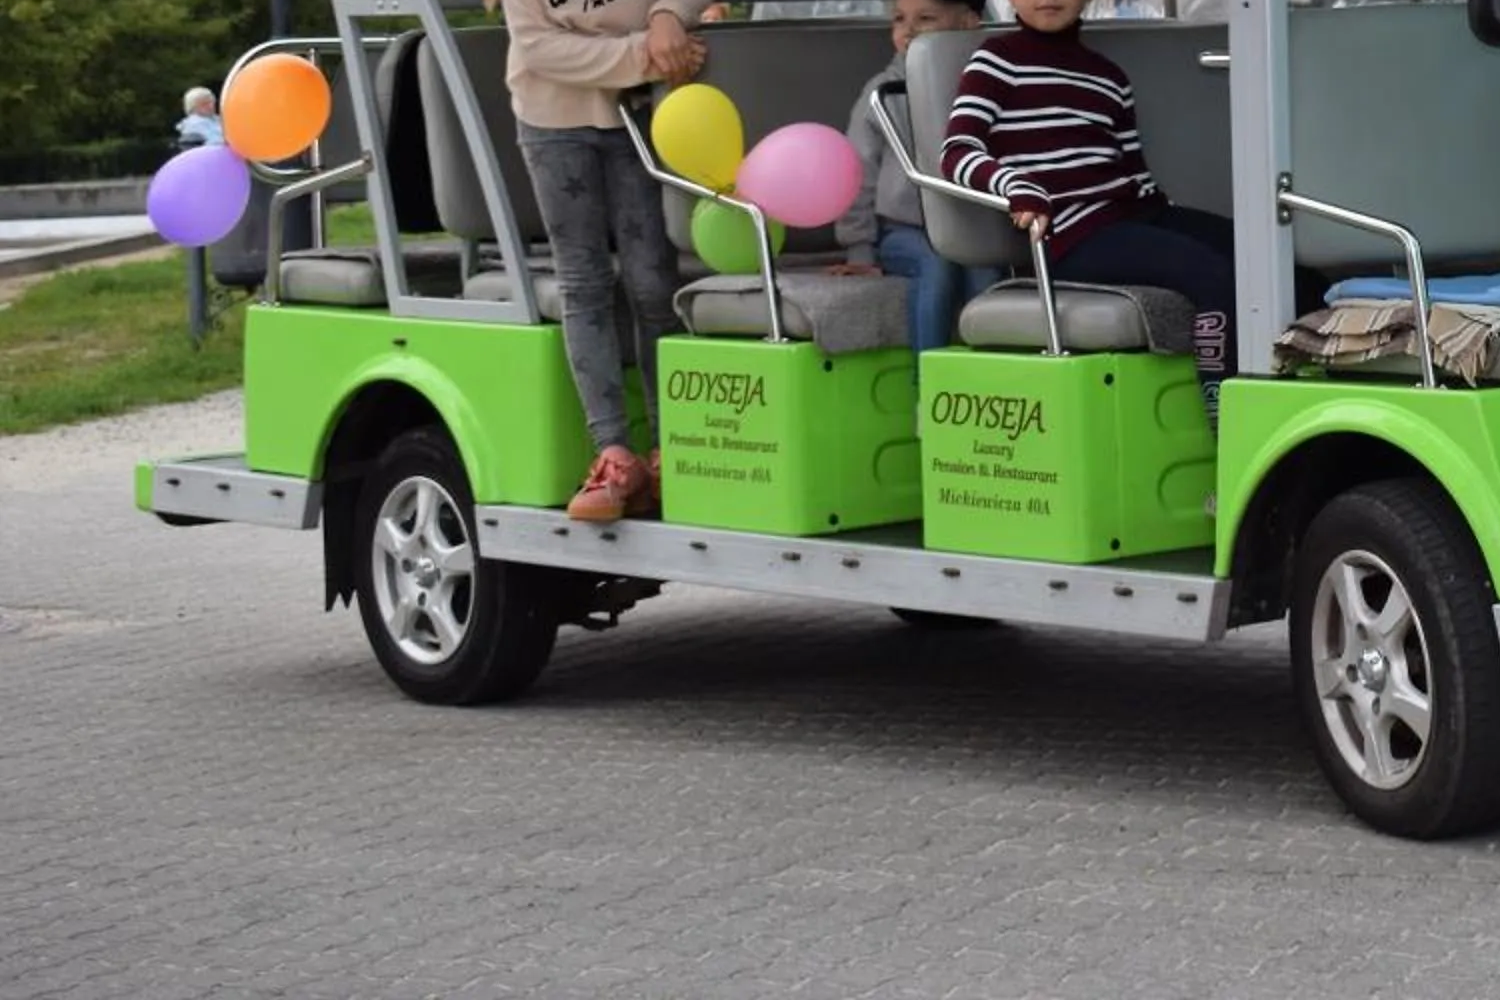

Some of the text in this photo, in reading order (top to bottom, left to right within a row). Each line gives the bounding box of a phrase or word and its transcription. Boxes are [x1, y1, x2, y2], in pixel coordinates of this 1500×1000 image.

[666, 369, 768, 415] ODYSEJA
[931, 391, 1047, 441] ODYSEJA
[972, 439, 1015, 461] Luxury
[932, 457, 1058, 484] Pension & Restaurant
[938, 486, 1052, 516] Mickiewicza 40A
